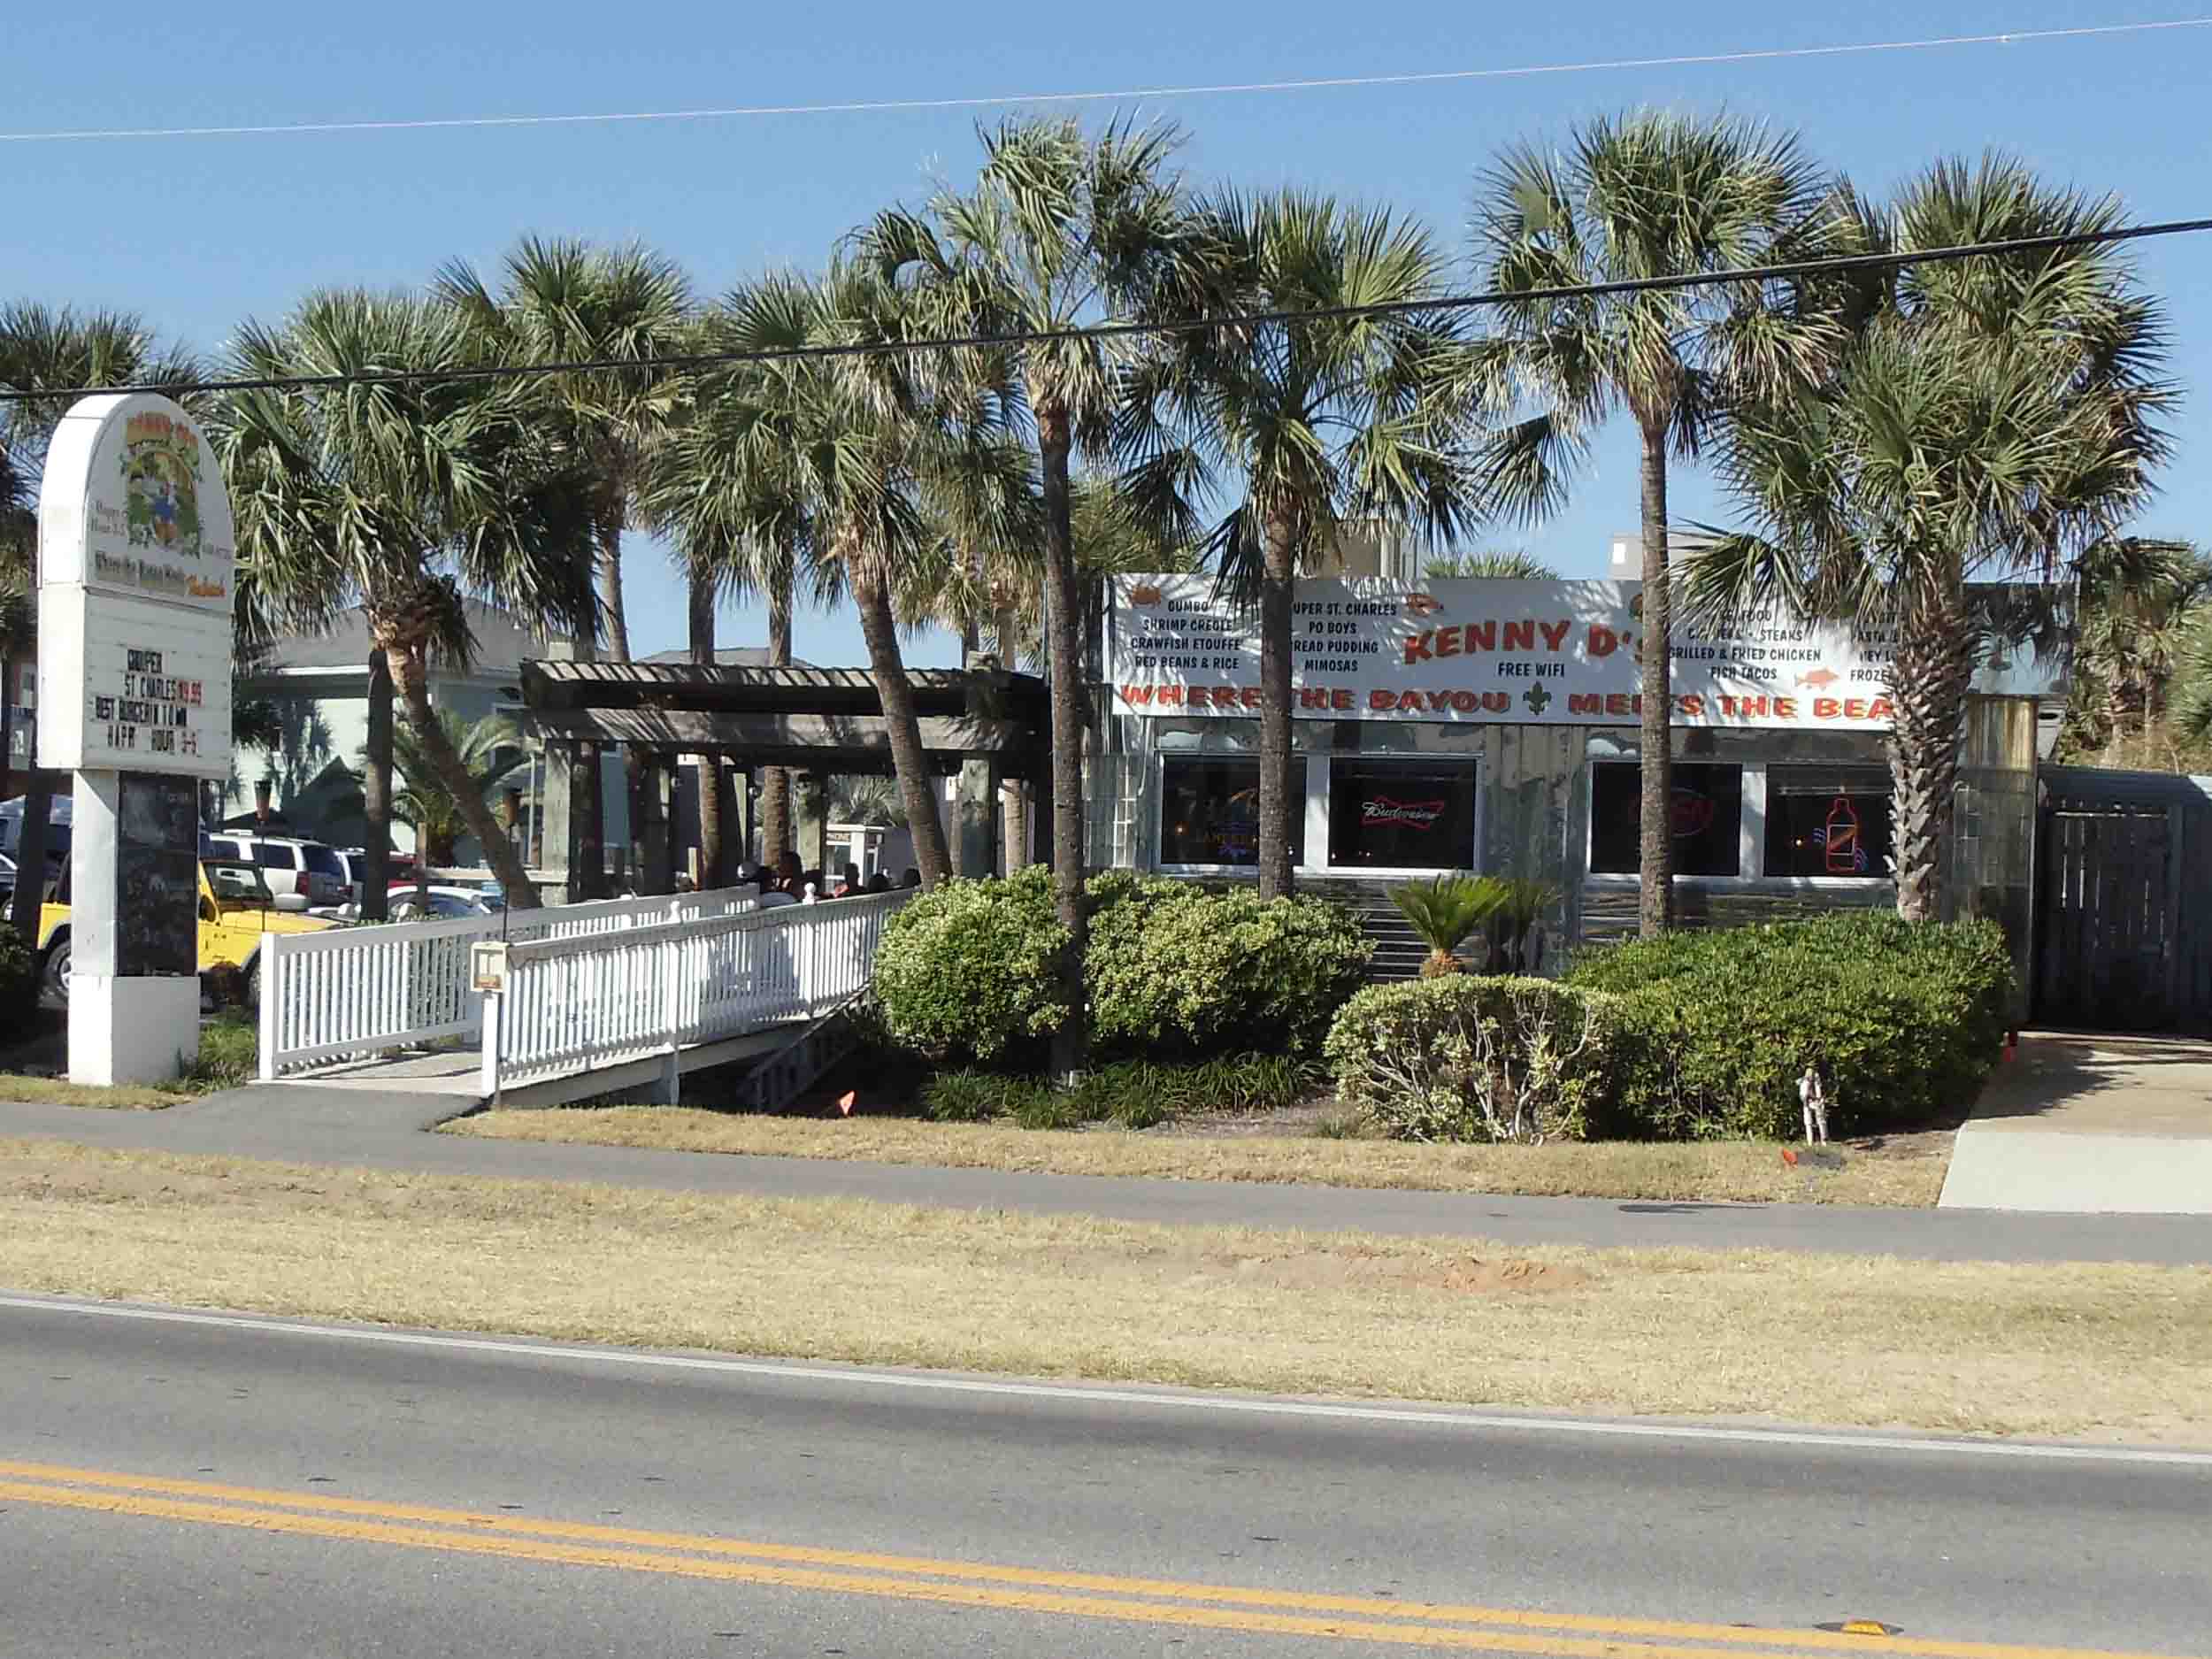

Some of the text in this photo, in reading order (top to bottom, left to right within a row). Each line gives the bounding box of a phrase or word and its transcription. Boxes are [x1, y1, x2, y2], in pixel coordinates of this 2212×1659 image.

[1168, 600, 1208, 612] GUMBO
[1293, 603, 1396, 616] UPER ST. CHARLES
[1143, 618, 1232, 632] SHRIMP CREOLE
[1310, 622, 1356, 634] PO BOYS
[1761, 629, 1802, 641] STEAKS
[1131, 637, 1188, 650] CRAWFISH
[1294, 640, 1378, 653] READ PUDDING
[1403, 620, 1571, 664] KENNY
[1670, 647, 1822, 662] GRILLED & FRIED CHICKEN
[1135, 657, 1239, 669] RED BEANS & RICE
[1305, 660, 1358, 672] MIMOSAS
[1498, 664, 1564, 677] FREE WIFI
[1710, 666, 1778, 680] FISH TACOS
[1850, 669, 1886, 682] FROZE
[1121, 684, 1894, 719] WHERE HE BAYOU MES THE BEA
